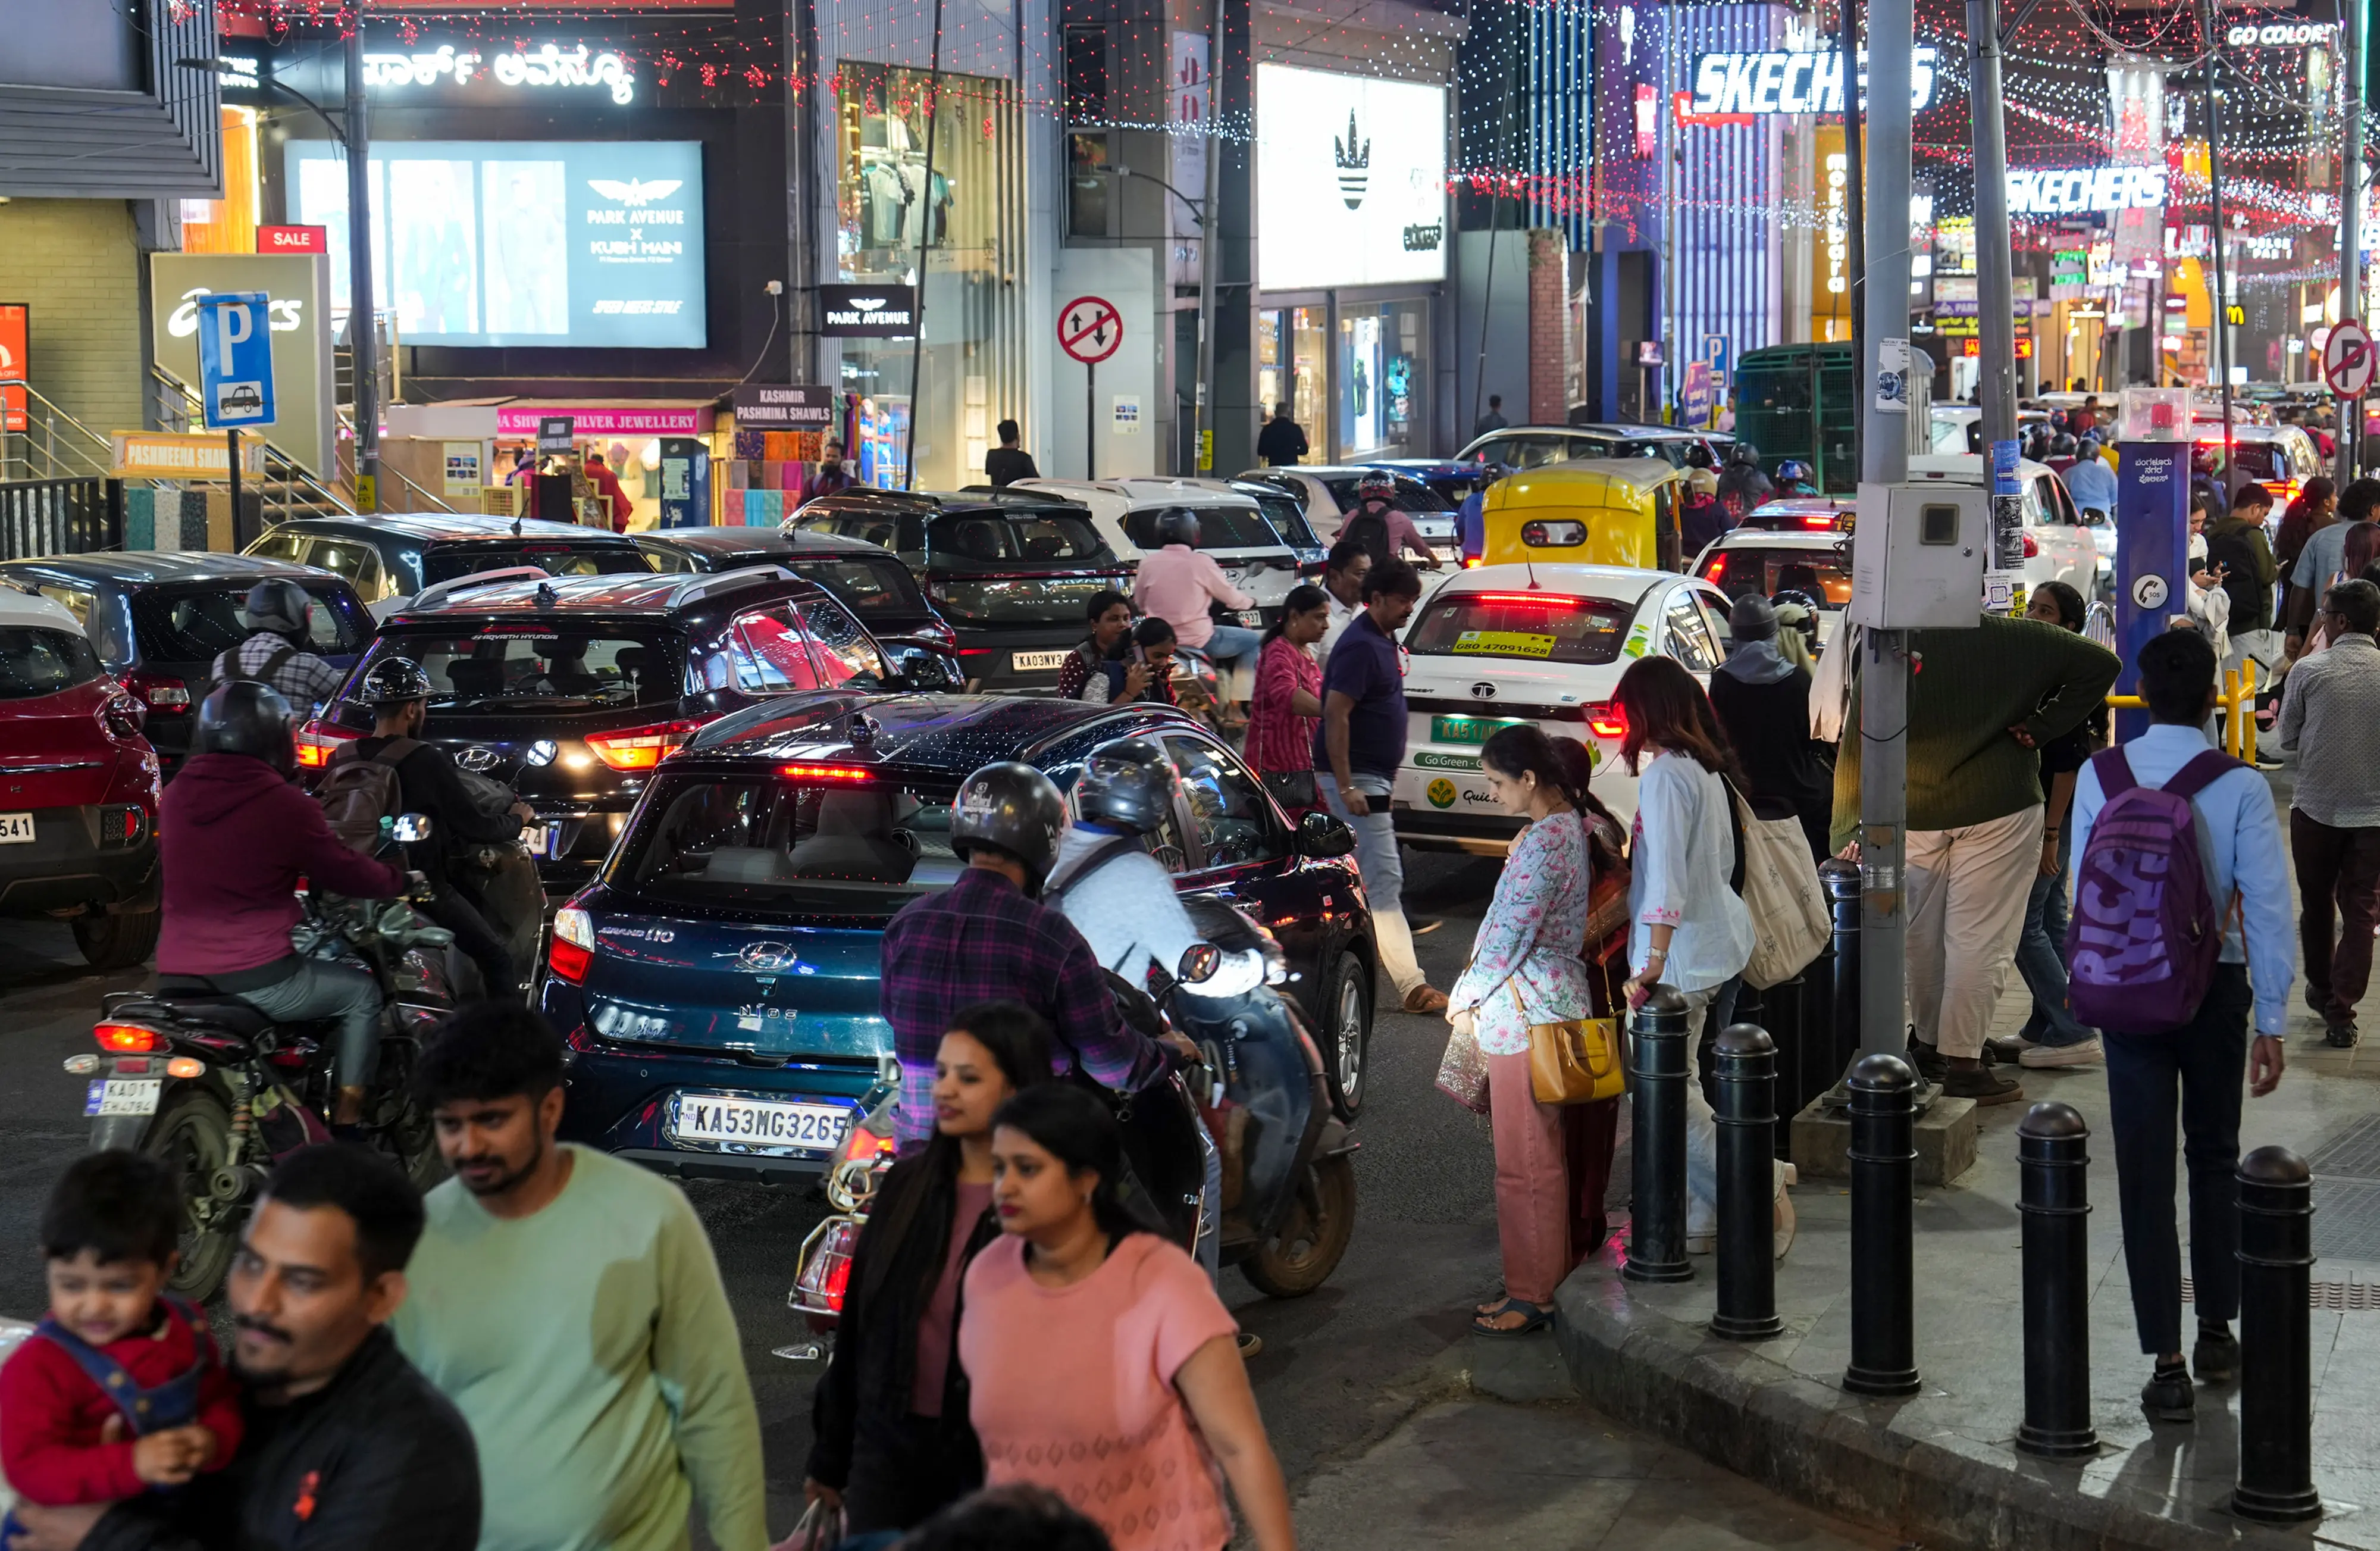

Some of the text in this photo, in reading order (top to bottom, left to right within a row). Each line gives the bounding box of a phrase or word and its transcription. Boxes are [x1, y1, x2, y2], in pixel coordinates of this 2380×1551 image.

[2228, 26, 2258, 45] GO
[1693, 48, 1939, 114] SKECHS
[2006, 164, 2168, 212] SKECHERS
[587, 209, 684, 224] PARK AVENUE
[273, 232, 311, 246] SALE
[826, 311, 910, 324] PARK AVENUE
[217, 303, 252, 377] P
[1709, 337, 1723, 370] P
[2341, 339, 2366, 387] P
[759, 389, 805, 404] KASHMIR
[617, 415, 696, 429] JEWELLERY
[737, 406, 831, 421] PASHMINA SHAWLS
[128, 445, 245, 470] PASHMEENA SHAWS
[1457, 642, 1548, 655] 080 47091628
[1019, 653, 1070, 668] KA03NY3
[1442, 721, 1510, 741] KA51AK
[1424, 754, 1438, 765] Go
[1440, 756, 1469, 767] Green
[0, 818, 29, 837] 541
[107, 1083, 146, 1097] KA01
[694, 1105, 847, 1142] KA53MG3265
